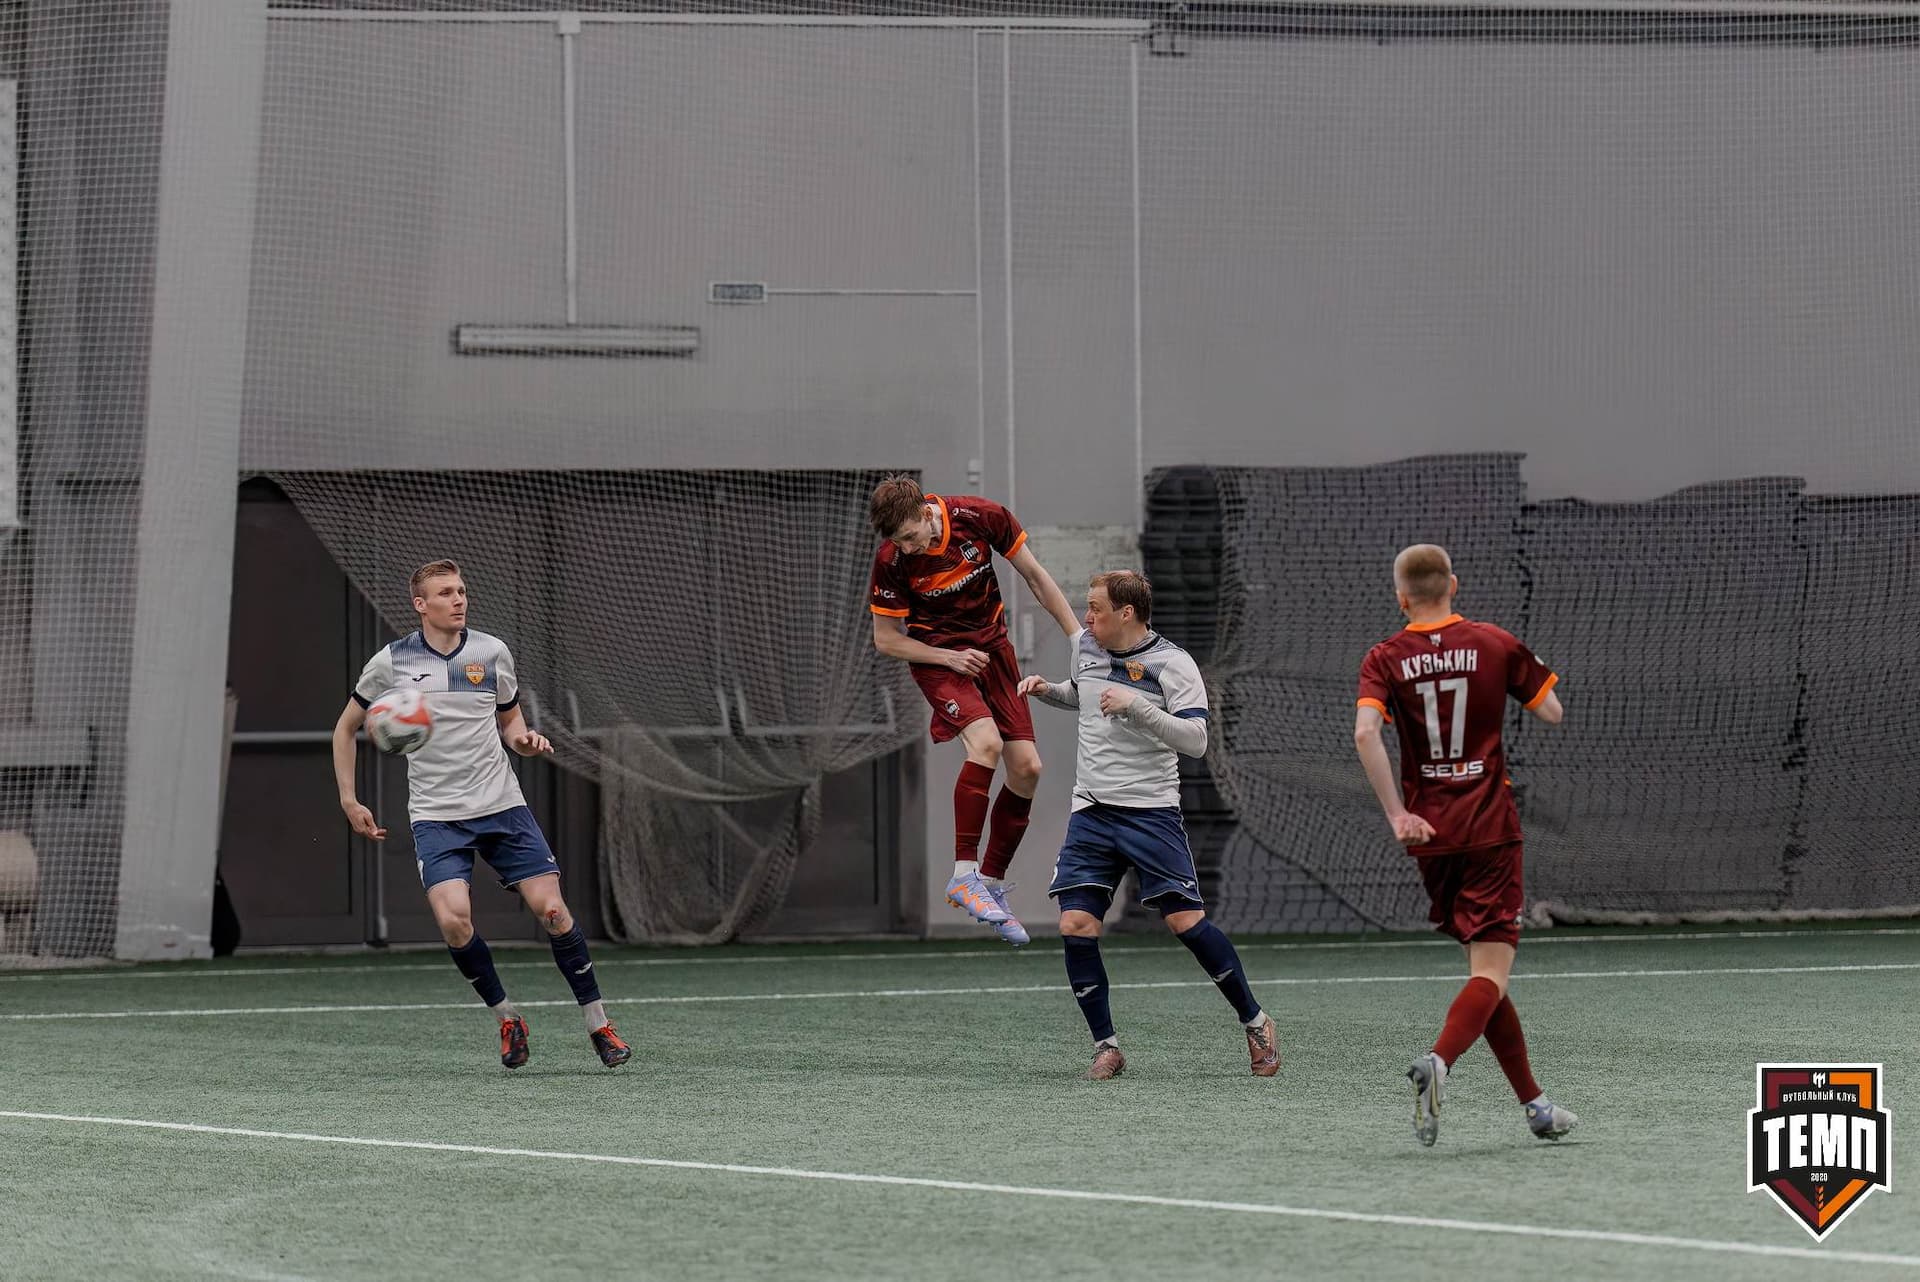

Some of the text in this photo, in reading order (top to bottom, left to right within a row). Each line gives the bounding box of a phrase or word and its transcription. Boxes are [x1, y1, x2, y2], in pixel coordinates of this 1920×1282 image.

[1401, 649, 1478, 680] КУЗЬКИН
[1415, 677, 1469, 760] 17
[1421, 760, 1484, 778] SEUS
